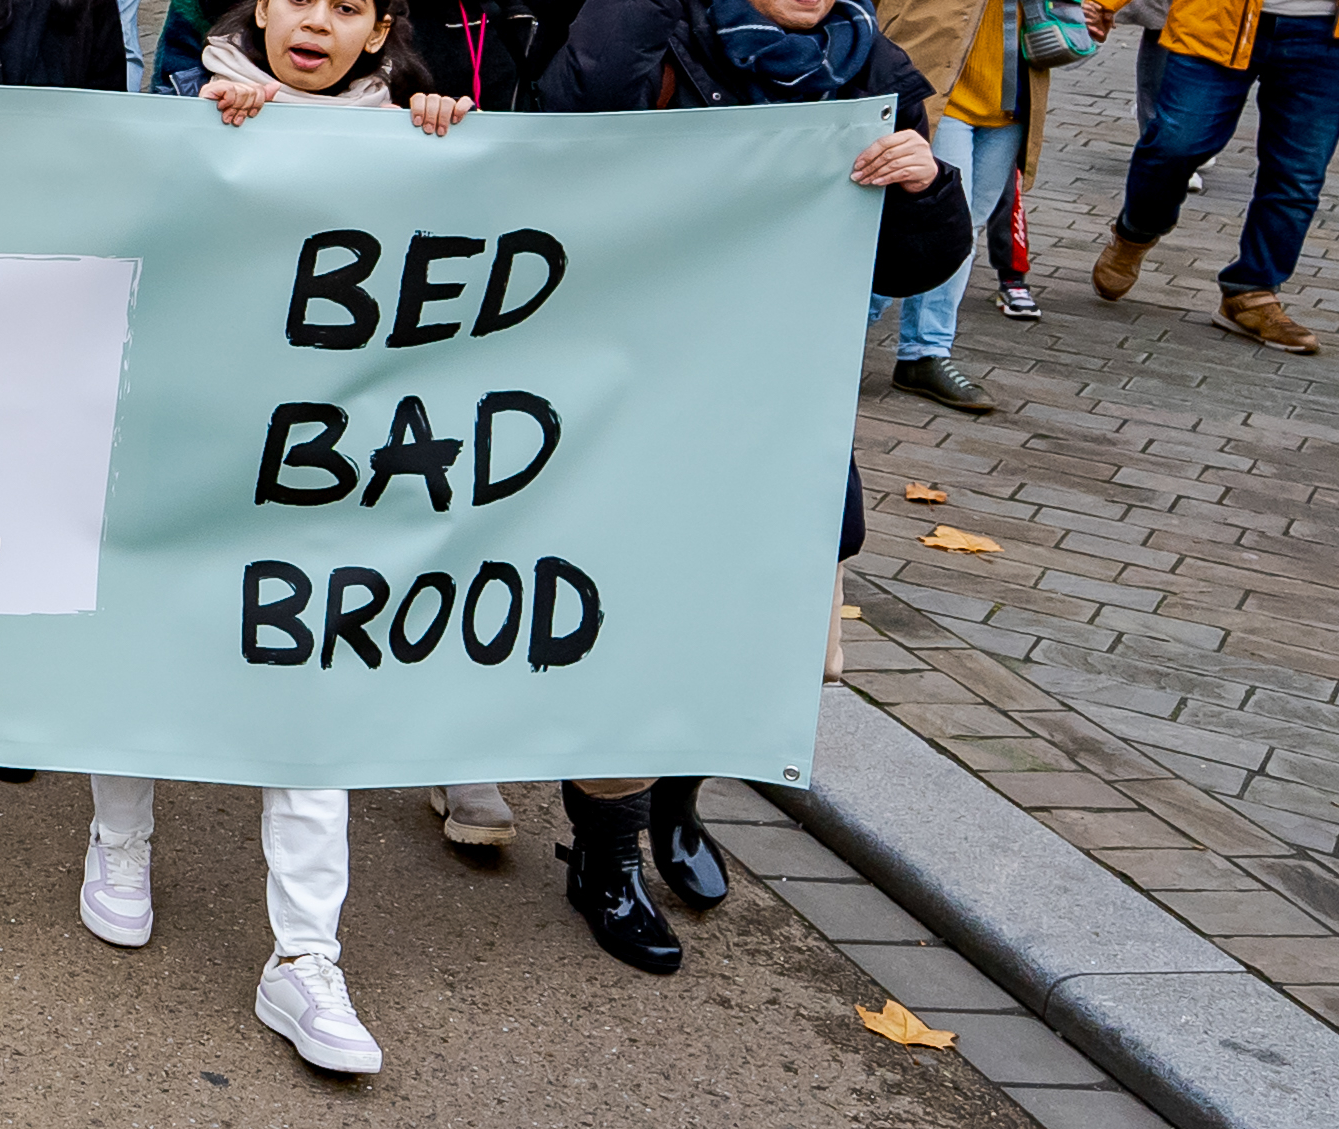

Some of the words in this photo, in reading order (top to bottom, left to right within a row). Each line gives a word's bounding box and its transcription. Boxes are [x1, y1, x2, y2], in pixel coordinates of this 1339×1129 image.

[285, 228, 568, 350] BED
[254, 390, 562, 512] BAD
[242, 556, 605, 673] BROOD
